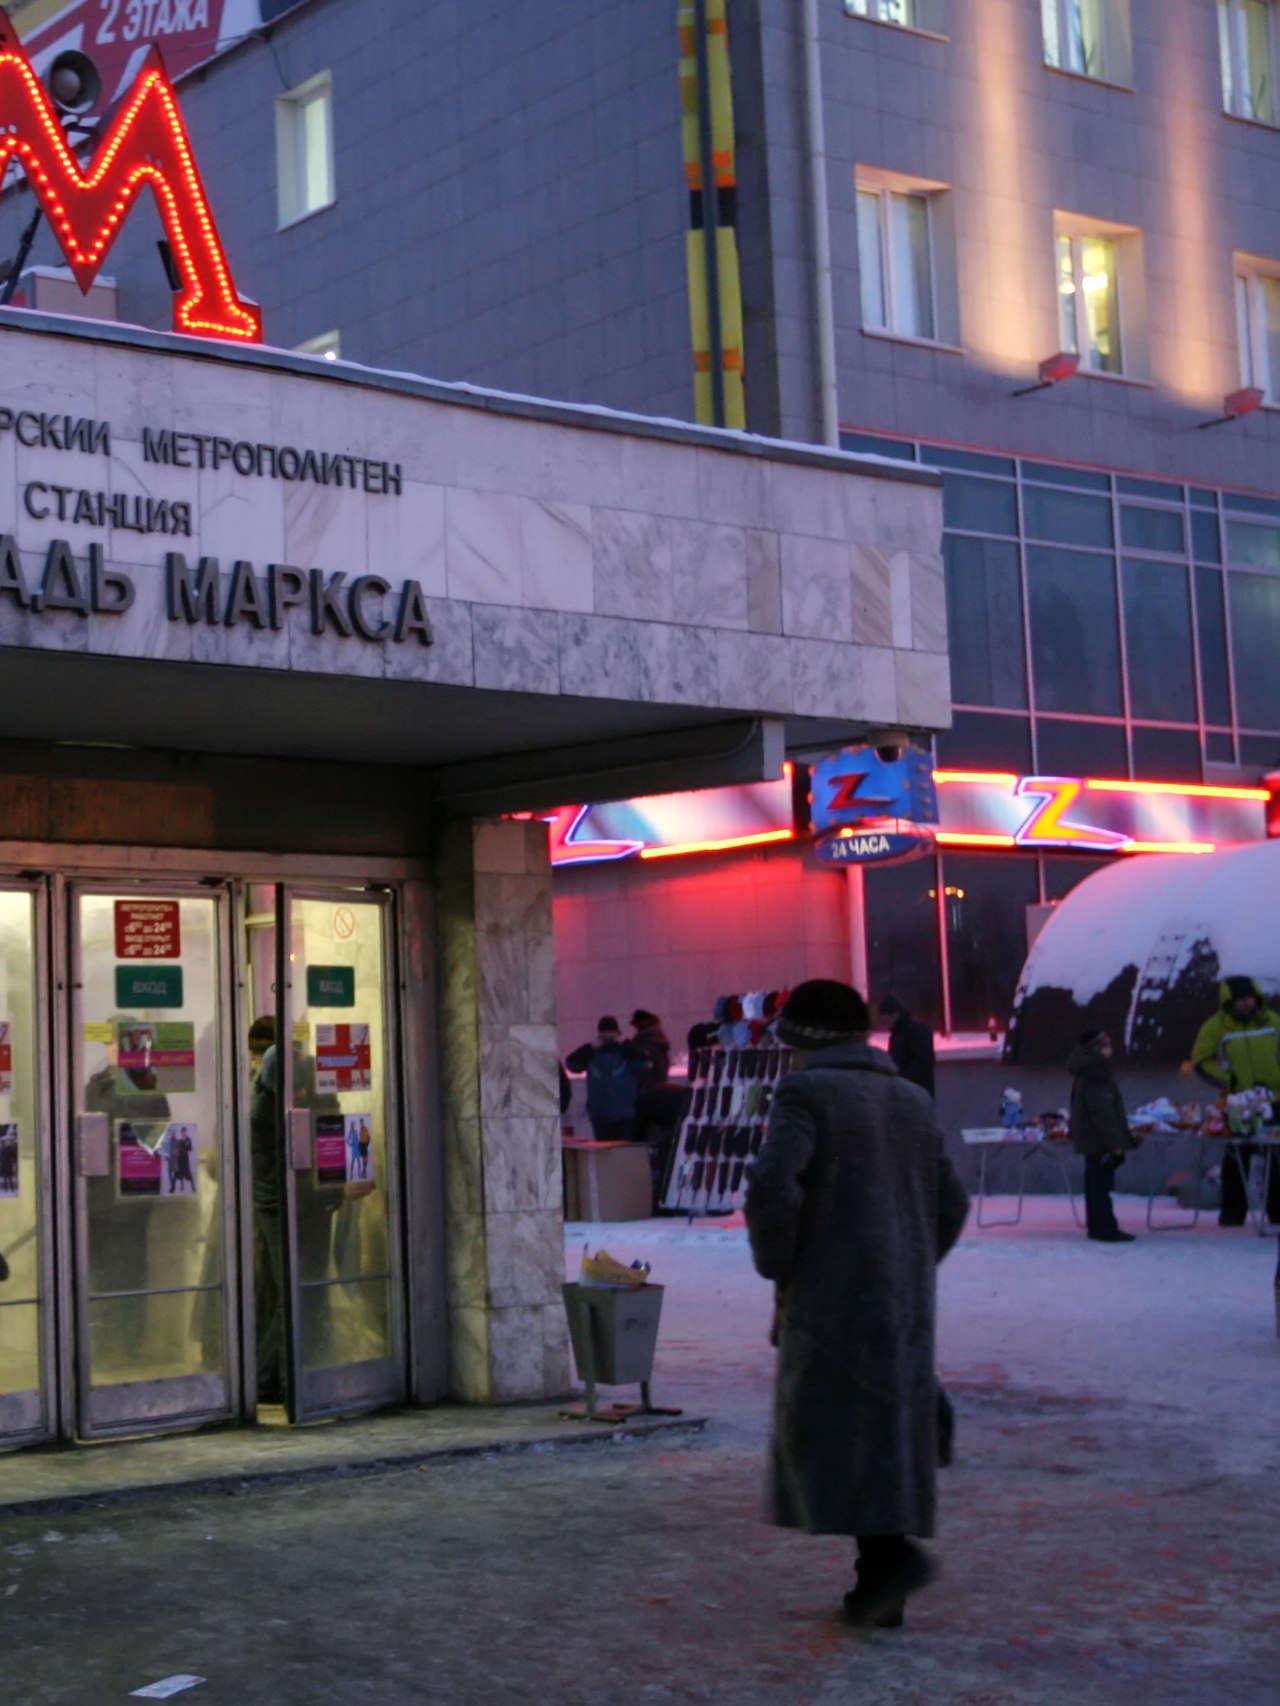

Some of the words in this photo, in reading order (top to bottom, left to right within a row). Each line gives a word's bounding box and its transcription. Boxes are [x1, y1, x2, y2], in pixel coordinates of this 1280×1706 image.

[94, 0, 120, 45] 2
[122, 0, 209, 41] ЭТАЖА
[142, 427, 403, 497] МЕТРОПОЛИТЕН
[23, 481, 192, 536] СТАНЦИЯ
[164, 551, 434, 647] МАРКСА
[831, 841, 848, 860] 24
[848, 835, 891, 856] ЧАСА
[132, 980, 168, 996] вход
[319, 980, 345, 996] вход
